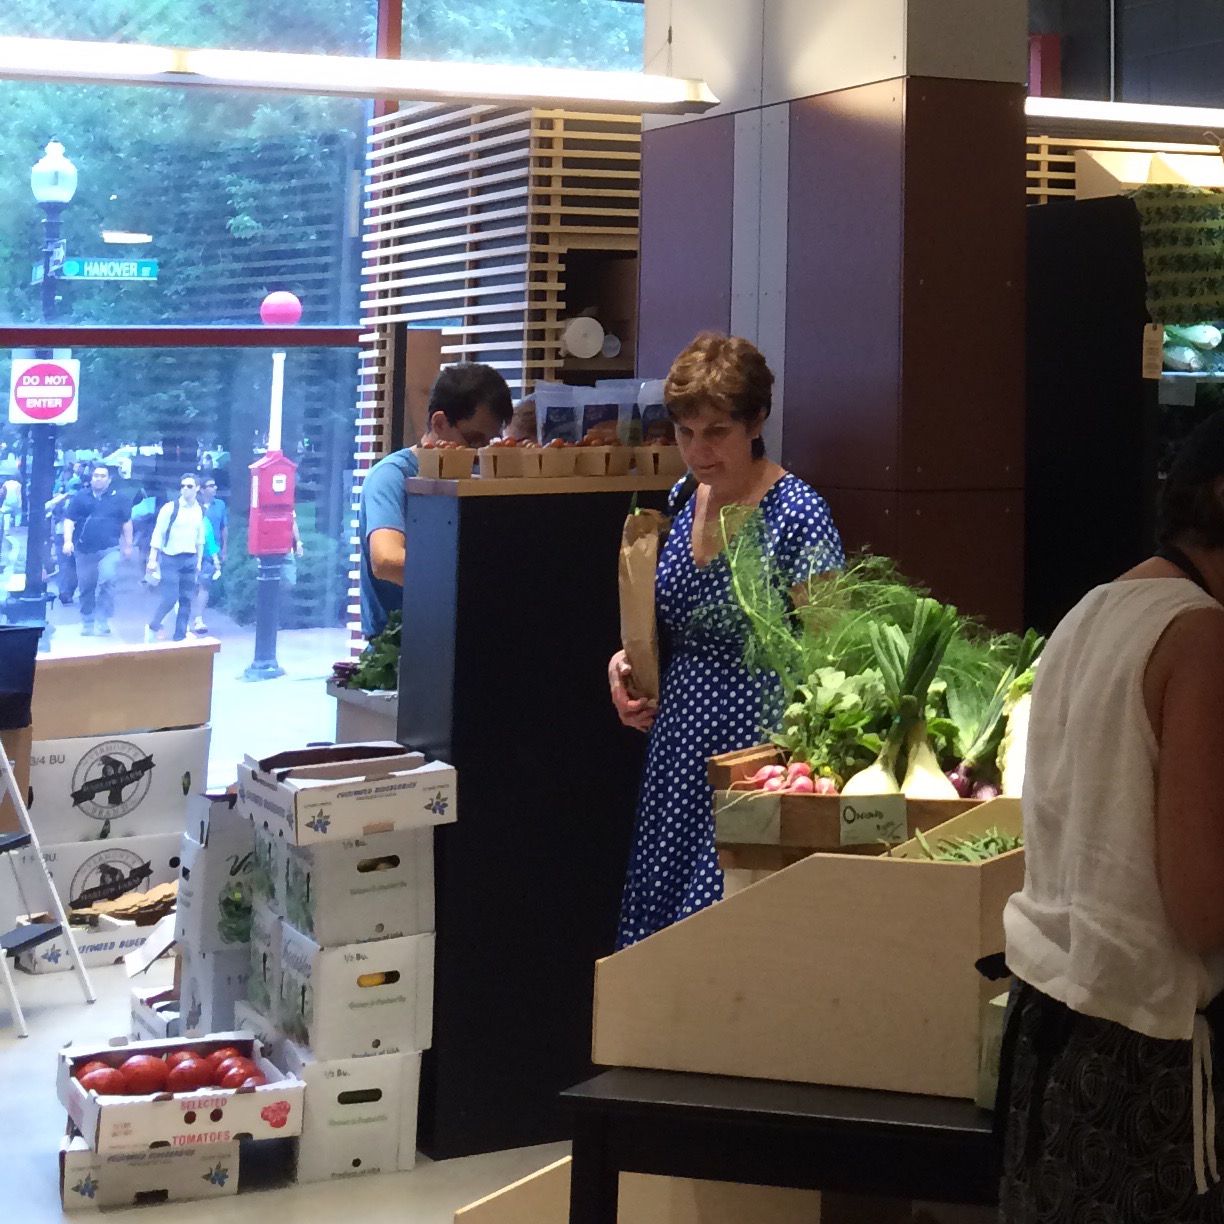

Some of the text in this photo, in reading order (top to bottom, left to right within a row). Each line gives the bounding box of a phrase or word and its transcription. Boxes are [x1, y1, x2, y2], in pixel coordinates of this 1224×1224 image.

[84, 261, 138, 277] HANOVER
[22, 375, 69, 386] DO NOT
[26, 398, 63, 409] ENTER
[49, 754, 66, 765] BU
[179, 1097, 228, 1111] SELECTED
[172, 1130, 231, 1146] TOMATOES
